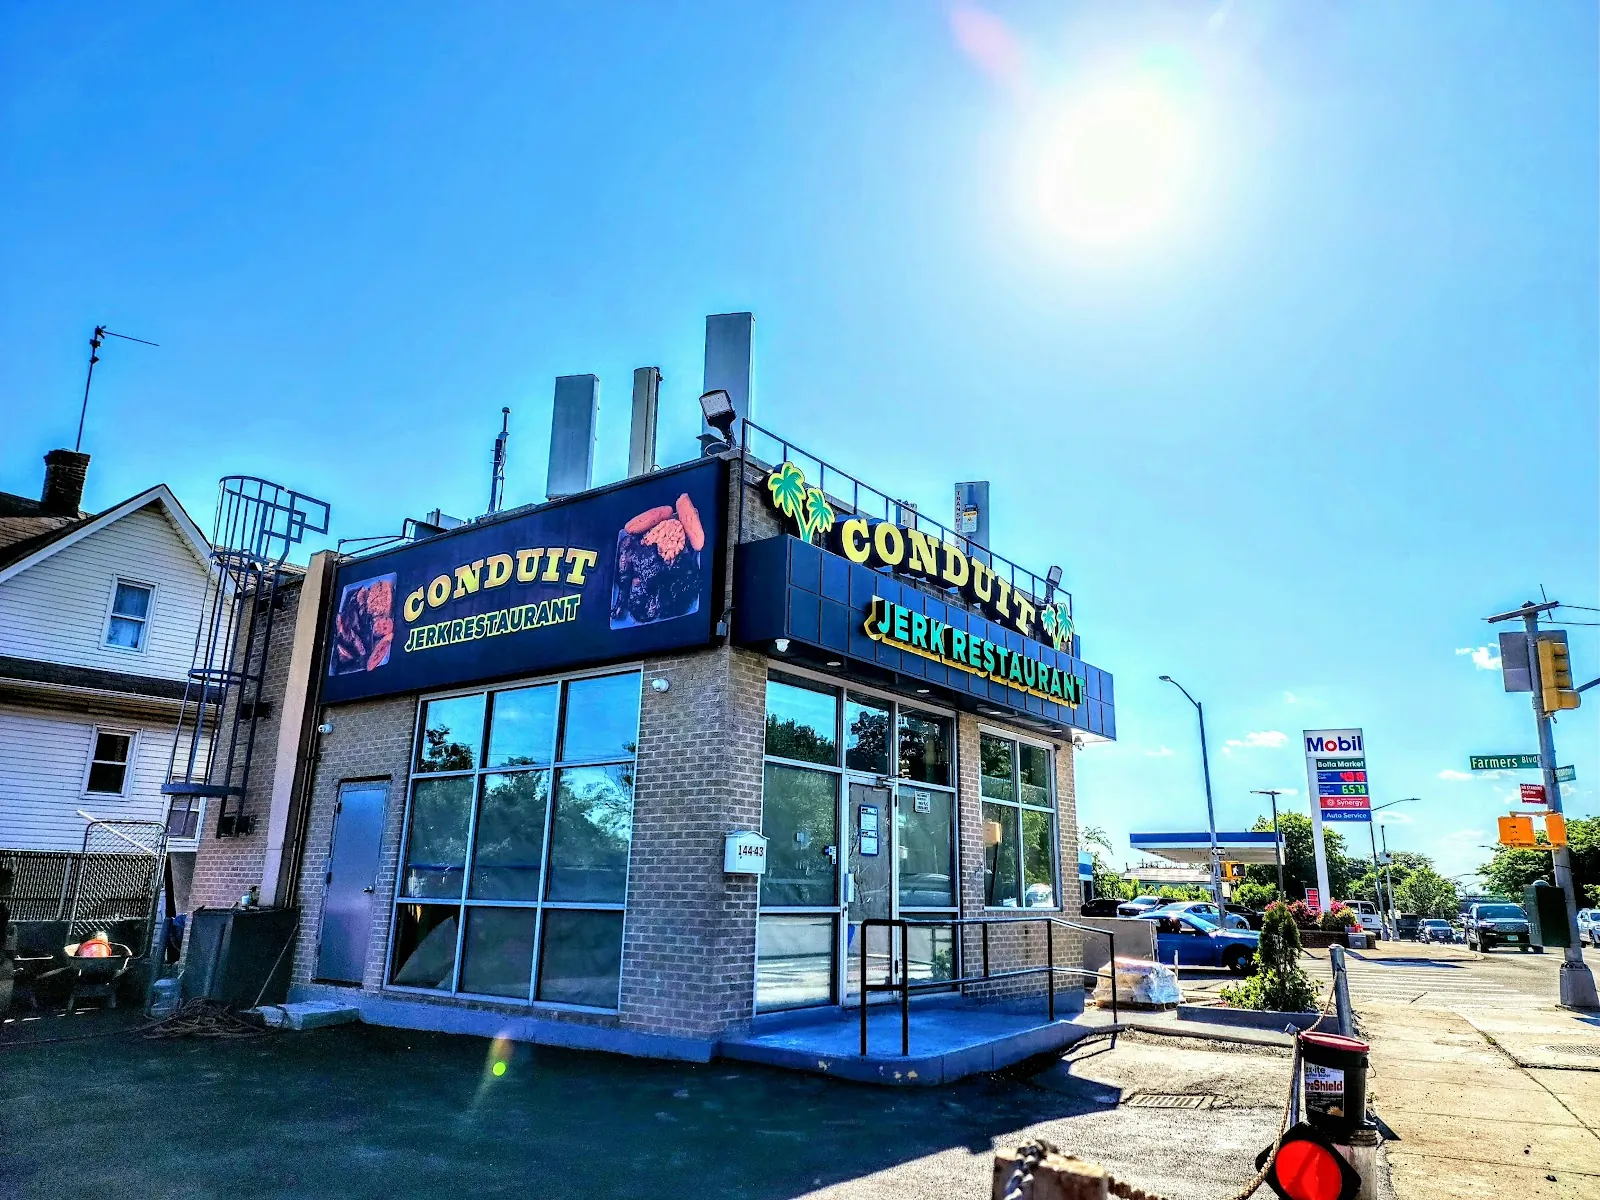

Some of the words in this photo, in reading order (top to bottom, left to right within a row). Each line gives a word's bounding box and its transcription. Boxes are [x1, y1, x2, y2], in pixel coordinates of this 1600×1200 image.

[403, 547, 598, 623] CONDUIT
[841, 518, 1036, 637] CONDUIT
[404, 619, 451, 653] JERK
[450, 594, 581, 645] RESTAURANT
[877, 599, 945, 656] JERK
[952, 629, 1086, 705] RESTAURANT
[1306, 735, 1362, 752] Mobil
[1337, 760, 1364, 768] Market
[1471, 757, 1518, 769] Farmers
[1521, 755, 1537, 764] Blvd
[1336, 799, 1364, 807] Synergy
[738, 844, 764, 857] 144-43
